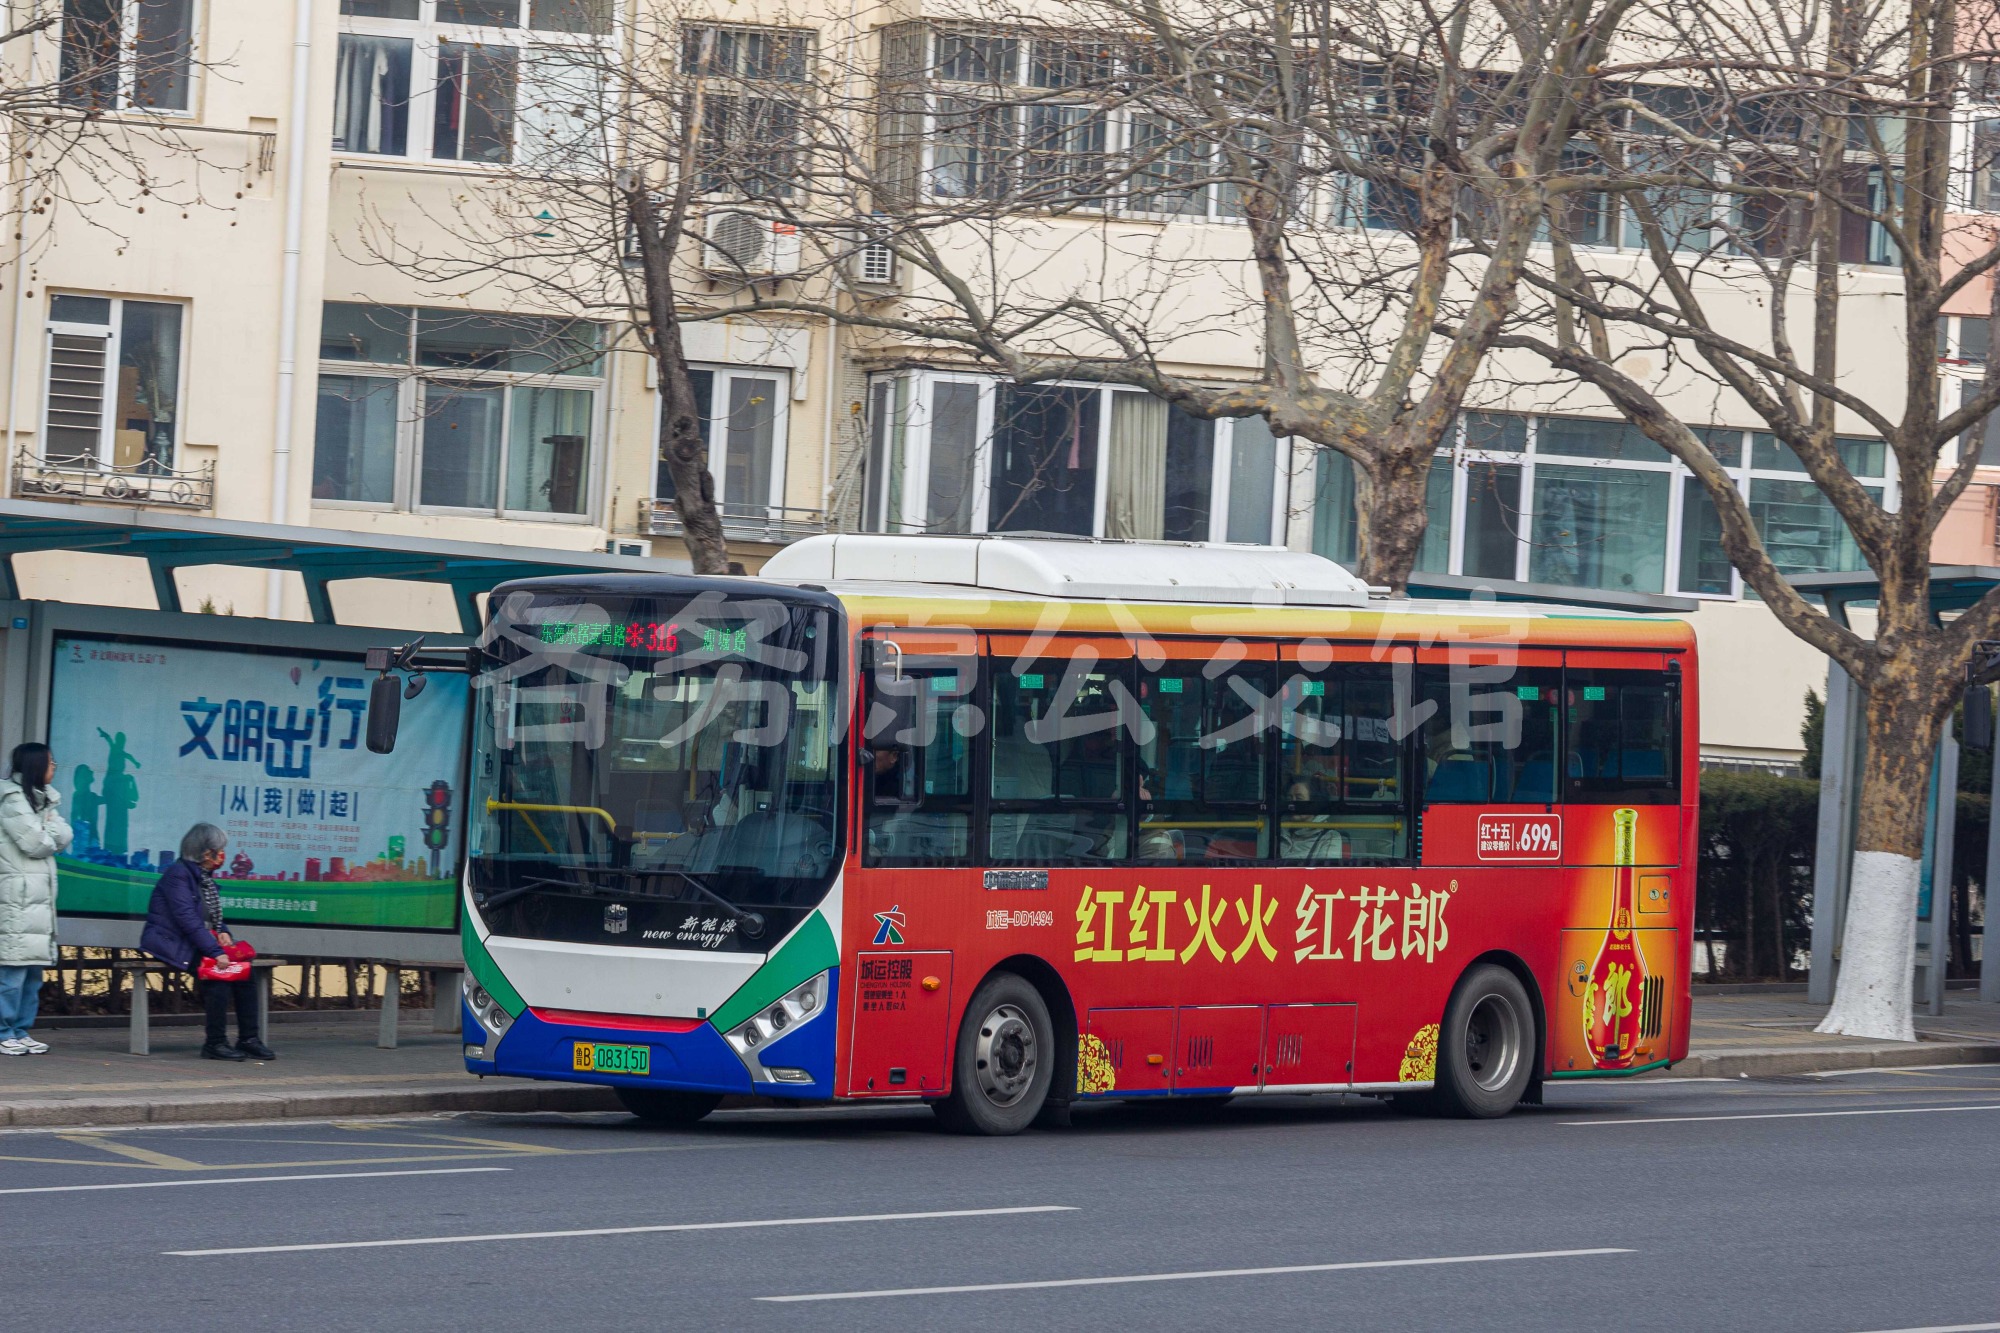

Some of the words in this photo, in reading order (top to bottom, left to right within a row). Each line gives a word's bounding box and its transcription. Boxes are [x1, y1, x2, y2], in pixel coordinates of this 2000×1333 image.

[646, 623, 679, 652] 316
[179, 676, 366, 778] 文明出行
[1480, 823, 1511, 840] 红十五
[679, 916, 738, 932] 新能源
[1074, 884, 1279, 964] 红红火火
[642, 929, 675, 940] new
[676, 931, 728, 948] energy
[861, 959, 913, 980] 城运控股
